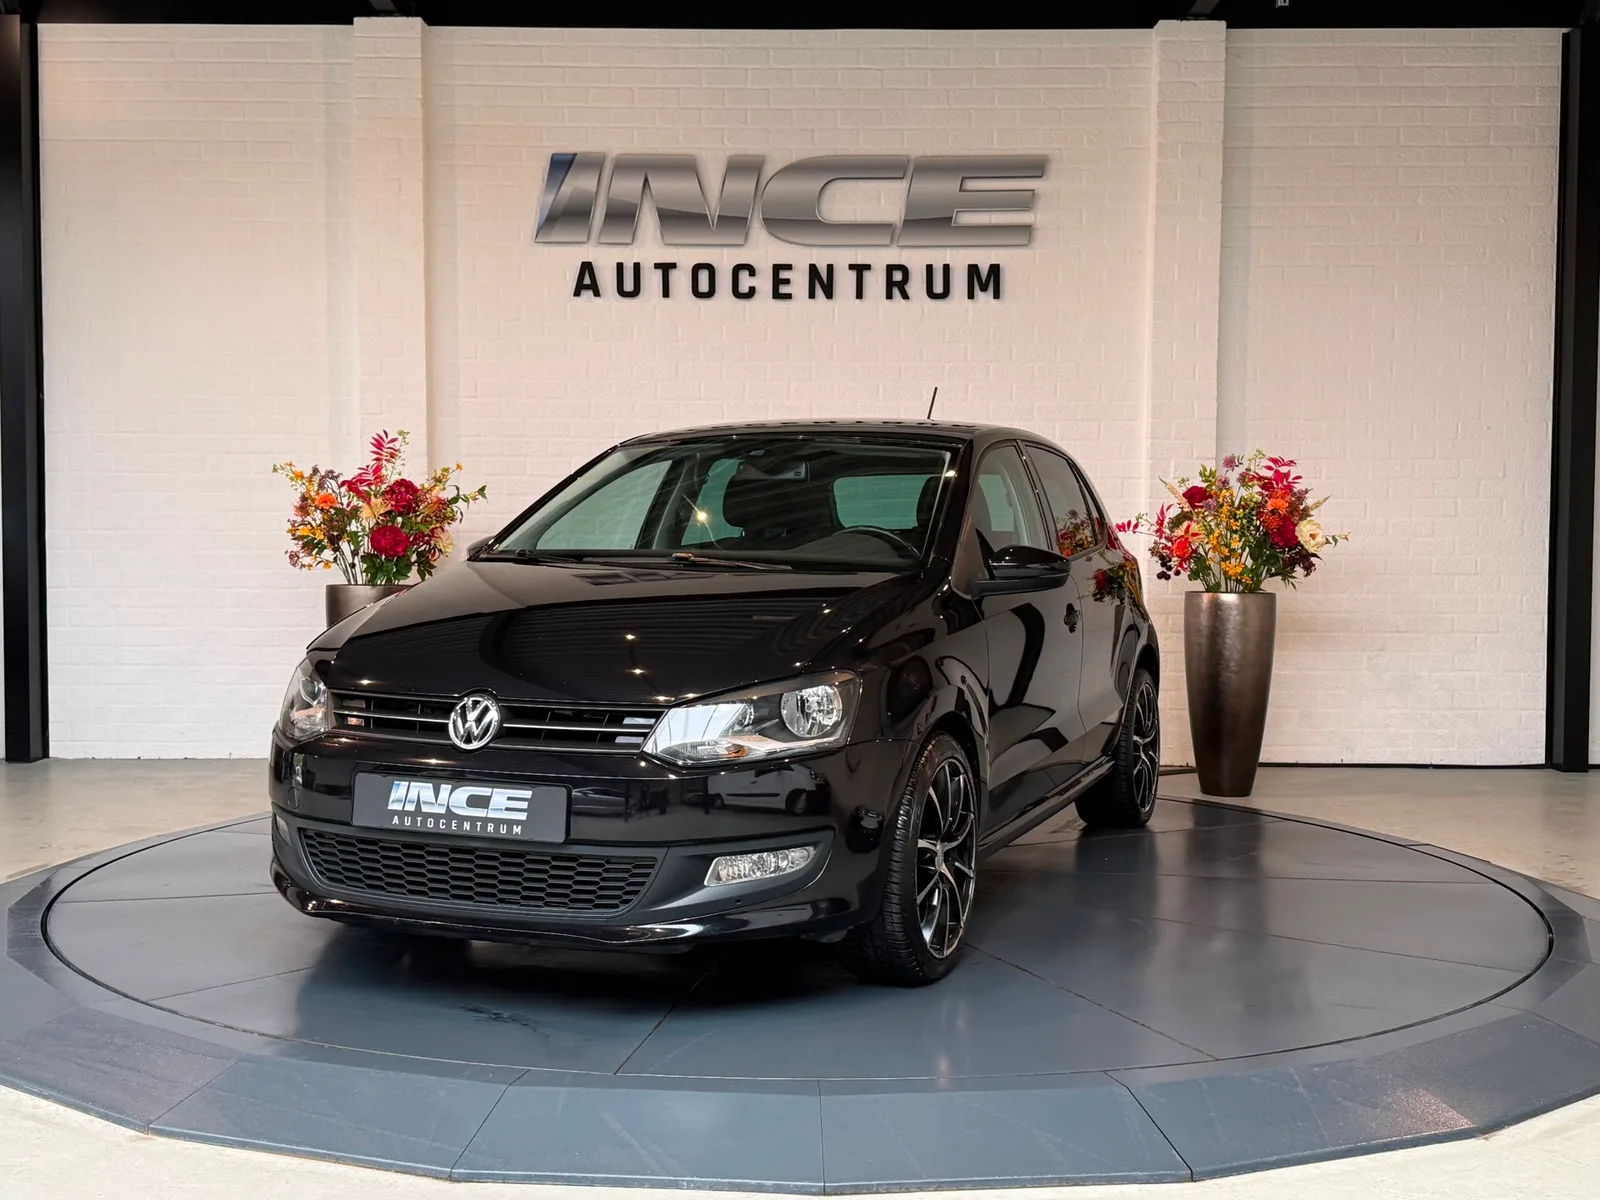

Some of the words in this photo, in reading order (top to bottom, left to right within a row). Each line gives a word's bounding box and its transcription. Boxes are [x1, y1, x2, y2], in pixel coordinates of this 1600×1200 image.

[535, 152, 1048, 247] INCE
[573, 261, 1001, 300] AUTOCENTRUM
[387, 780, 533, 821] INCE
[392, 815, 522, 835] AUTOCENTRUM
